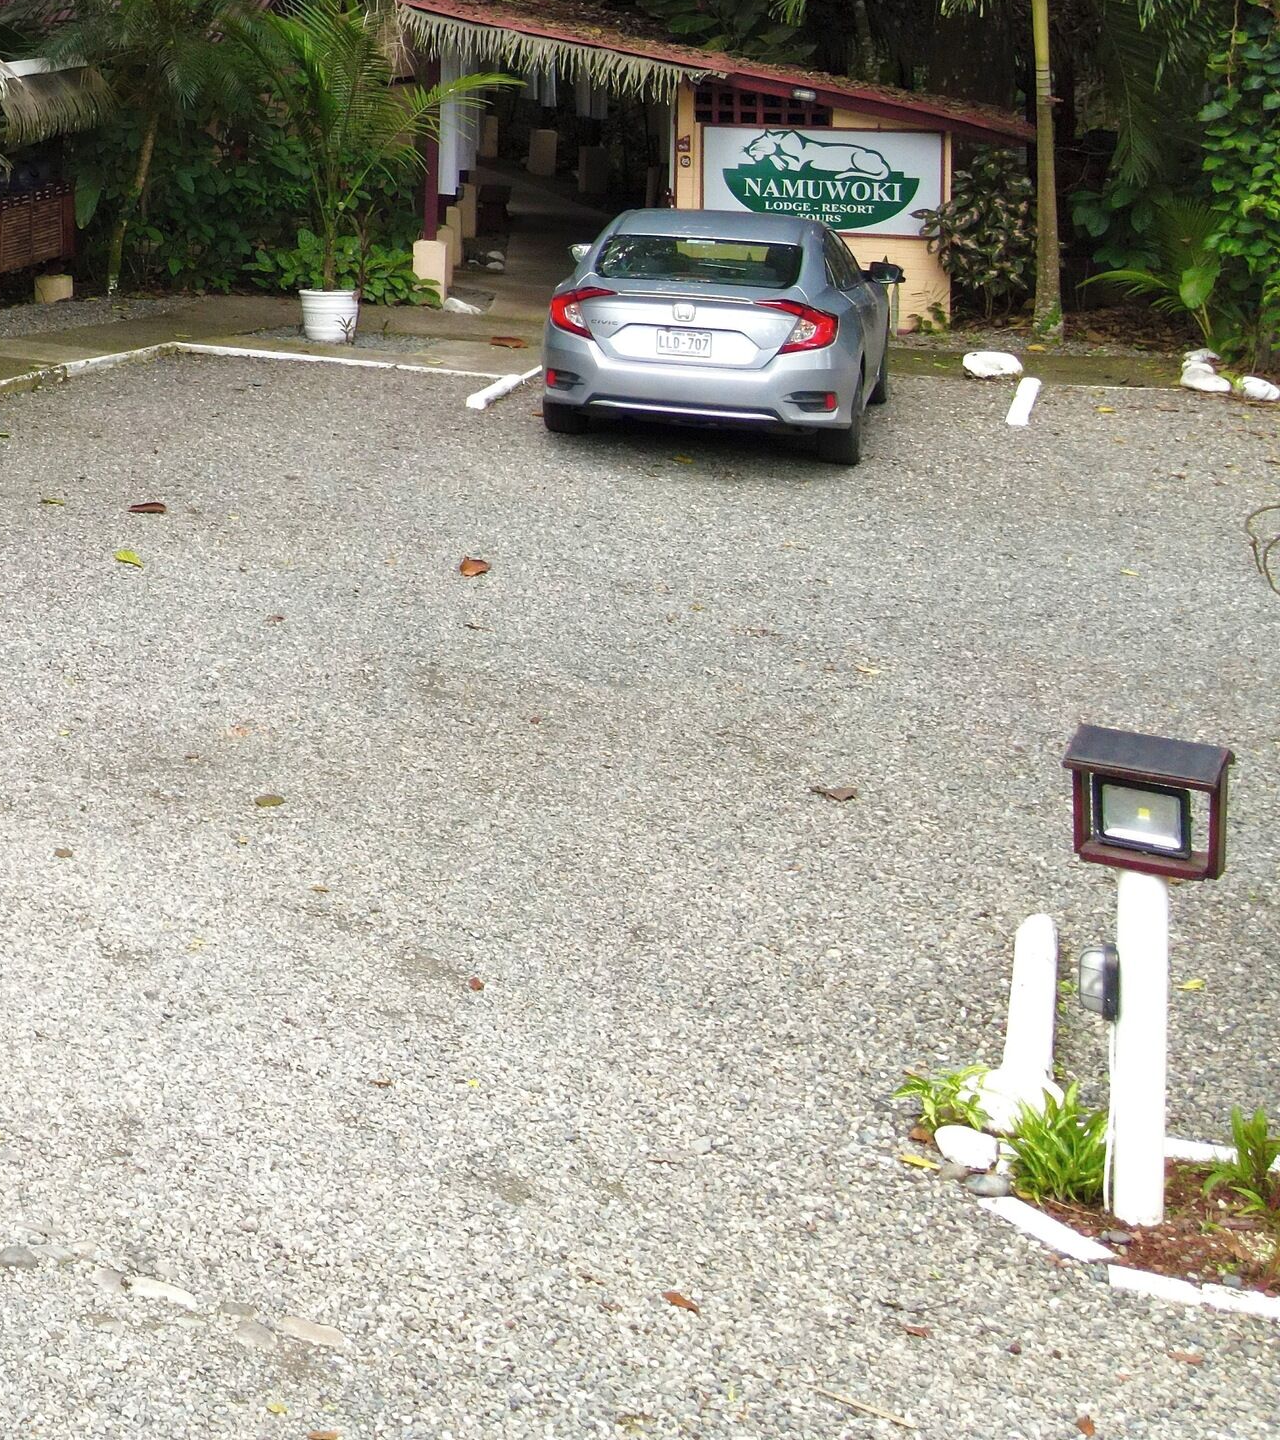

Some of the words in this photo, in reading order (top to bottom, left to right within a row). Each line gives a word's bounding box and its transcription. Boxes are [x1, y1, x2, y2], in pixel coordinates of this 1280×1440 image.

[743, 177, 903, 203] NAMUWOKI
[765, 201, 811, 212] LODGE
[822, 203, 875, 215] RESORT
[797, 213, 842, 223] TOURS
[659, 336, 709, 351] LLD-707
